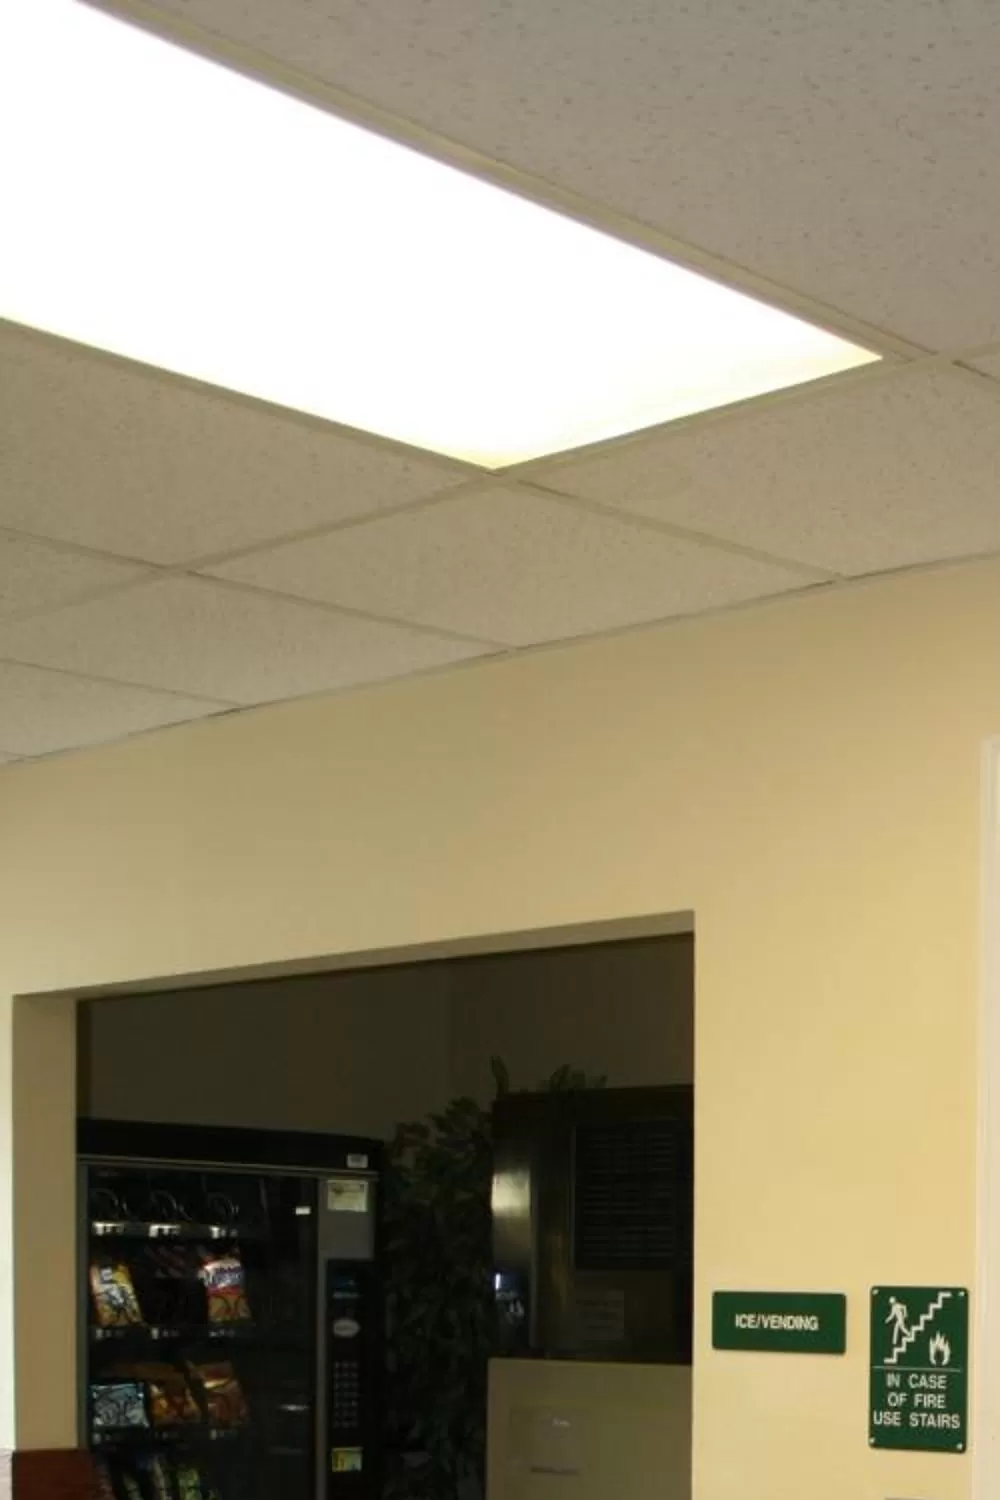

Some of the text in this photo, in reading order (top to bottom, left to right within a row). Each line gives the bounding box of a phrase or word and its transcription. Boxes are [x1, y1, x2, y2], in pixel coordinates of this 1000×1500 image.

[734, 1313, 819, 1331] ICE/VENDING
[887, 1373, 947, 1389] IN CASE
[888, 1392, 946, 1409] OF FIRE
[873, 1411, 960, 1429] USE STAIRS
